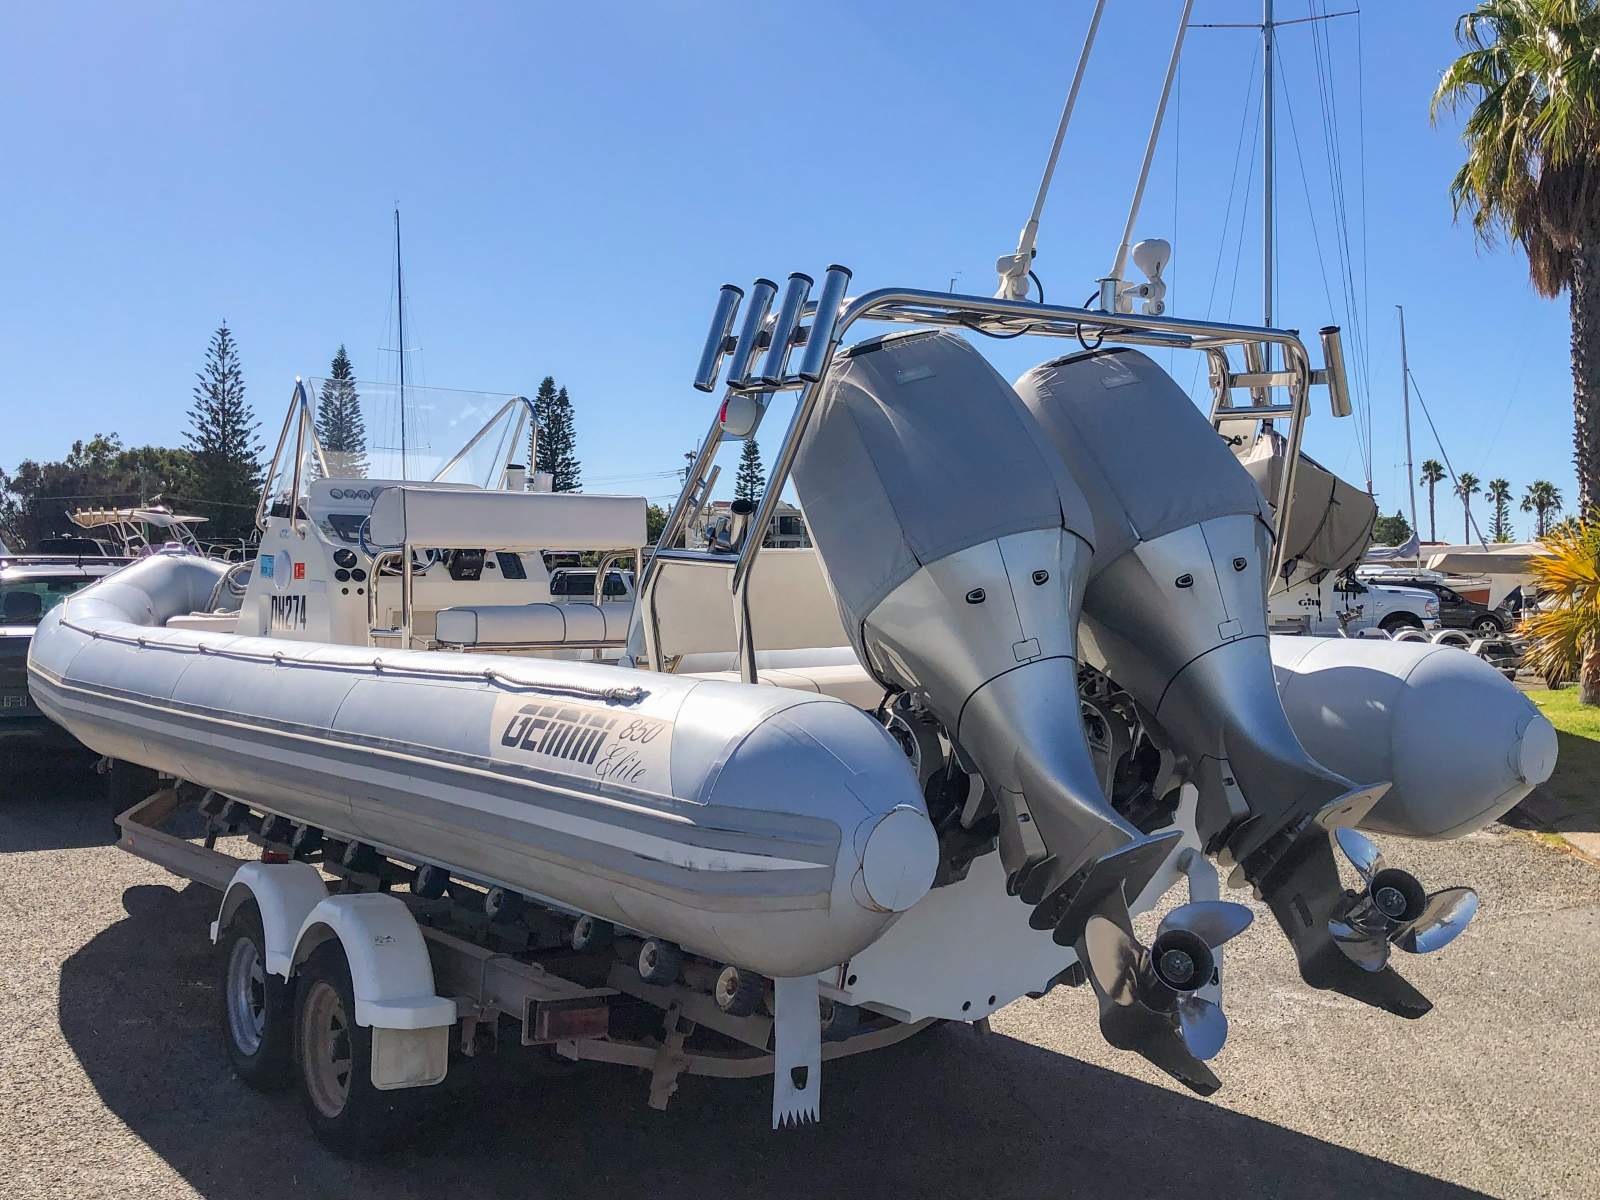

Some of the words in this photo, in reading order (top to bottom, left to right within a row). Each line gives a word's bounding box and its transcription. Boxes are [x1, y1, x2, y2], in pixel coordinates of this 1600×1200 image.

[271, 595, 306, 631] DH274
[619, 720, 665, 744] 850
[596, 743, 648, 784] Elite
